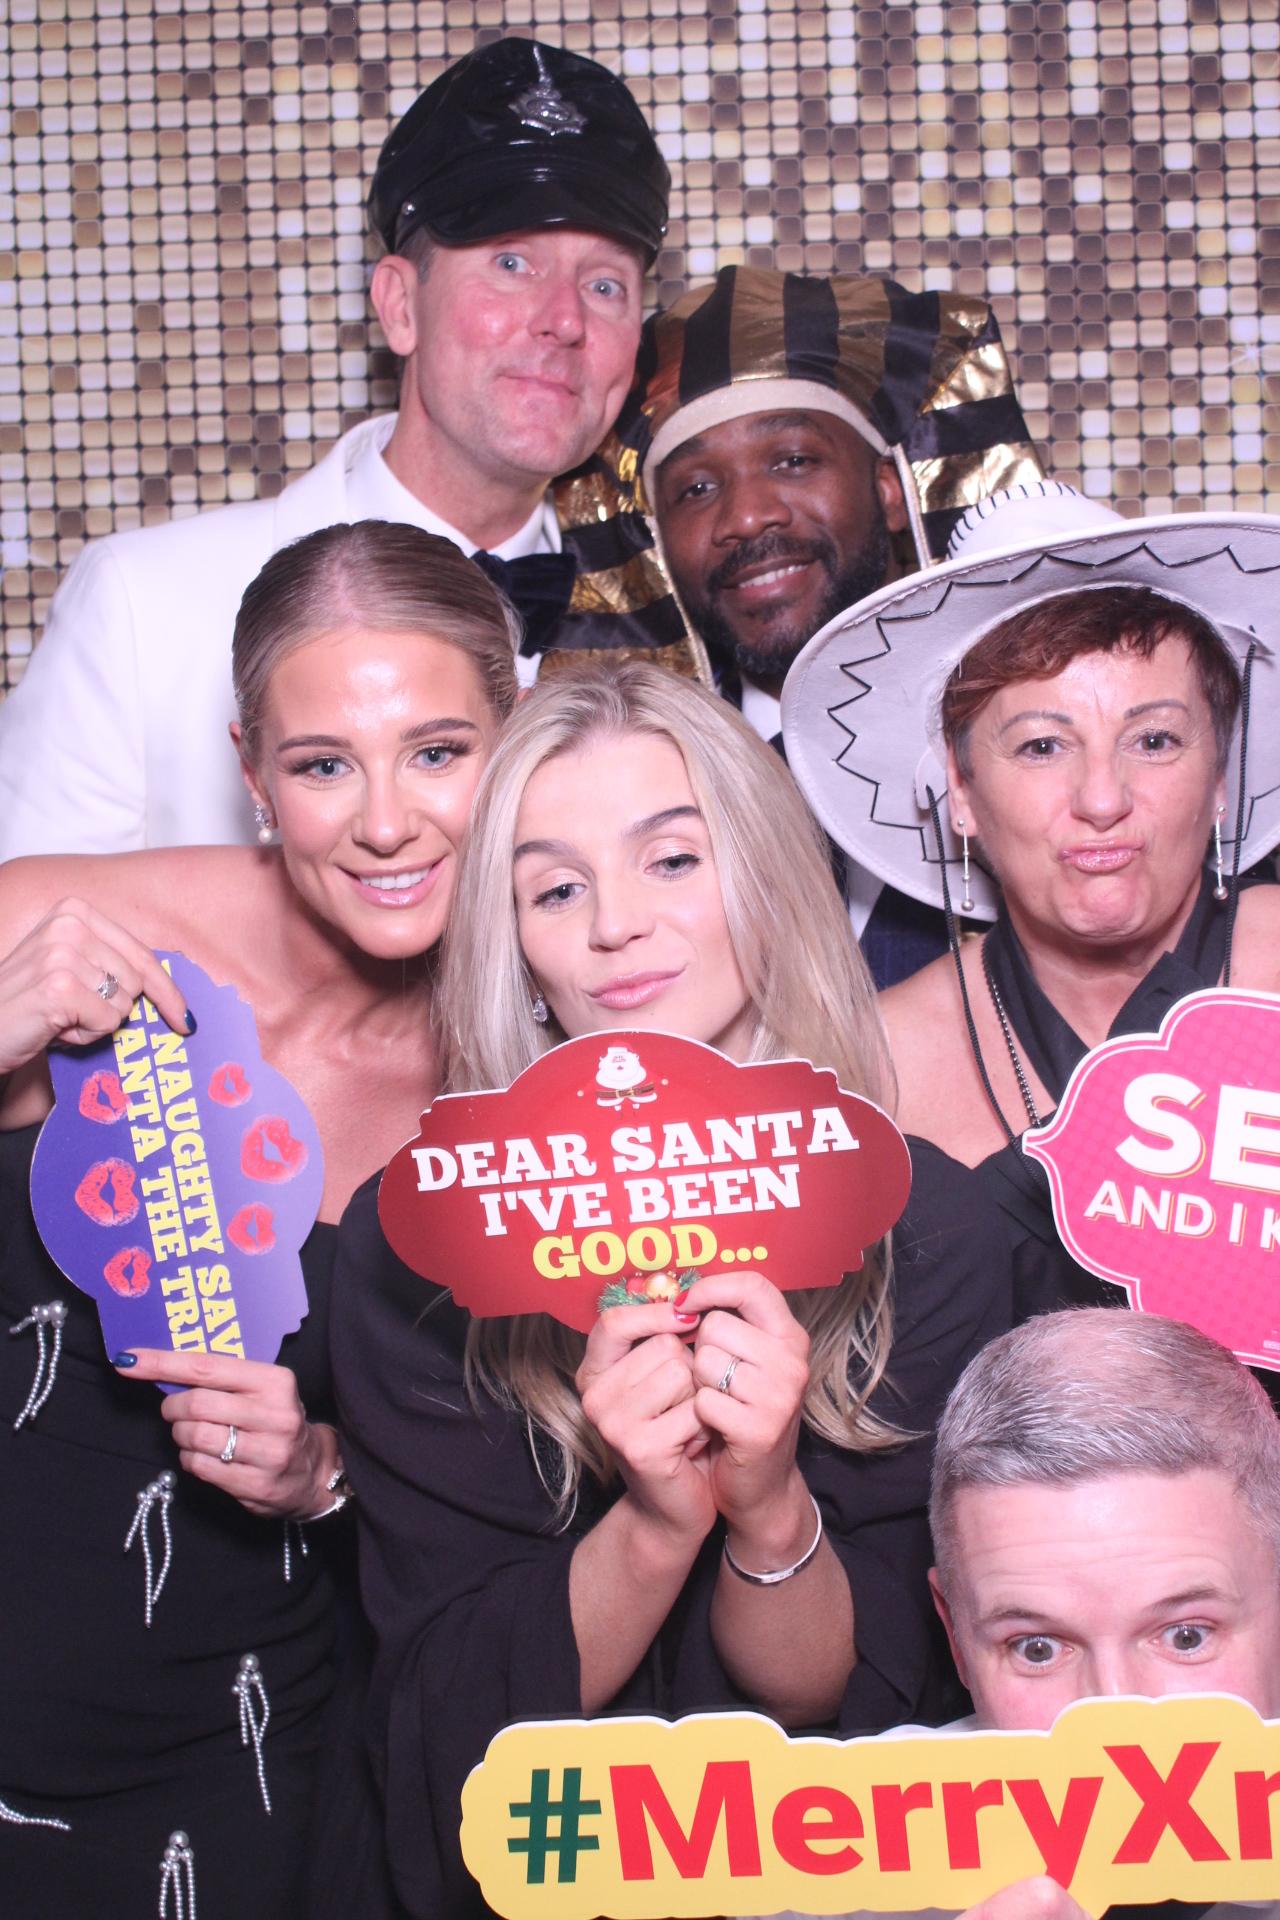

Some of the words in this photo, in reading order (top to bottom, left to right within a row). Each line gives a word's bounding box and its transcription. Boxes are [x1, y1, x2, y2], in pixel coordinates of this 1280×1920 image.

[411, 1132, 597, 1192] DEAR
[610, 1106, 860, 1174] SANTA
[141, 1166, 188, 1262] THE
[150, 1030, 224, 1255] NAUGHTY
[195, 1264, 246, 1360] SAV
[479, 1182, 608, 1237] I'VE
[628, 1163, 801, 1225] BEEN
[1083, 1180, 1216, 1239] AND
[1228, 1202, 1245, 1246] I
[532, 1223, 768, 1280] GOOD...
[160, 1266, 207, 1353] TRI
